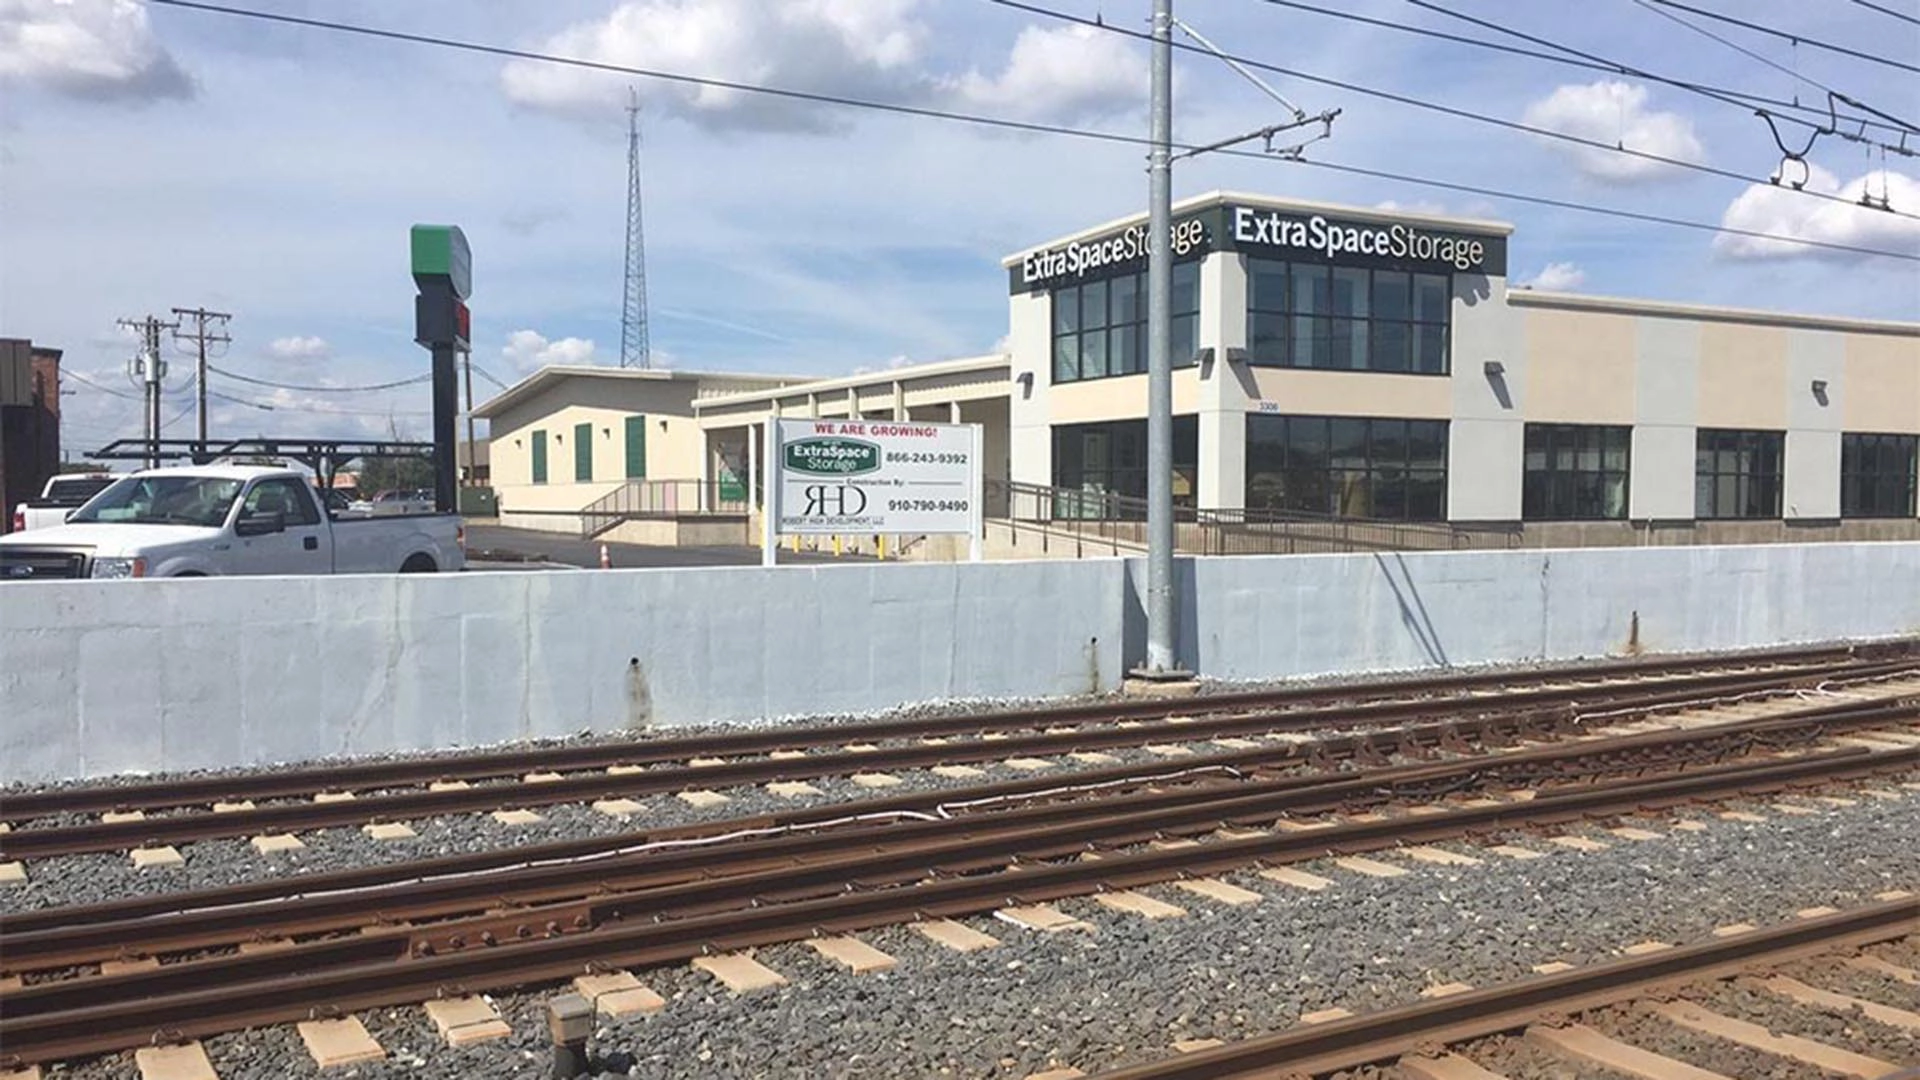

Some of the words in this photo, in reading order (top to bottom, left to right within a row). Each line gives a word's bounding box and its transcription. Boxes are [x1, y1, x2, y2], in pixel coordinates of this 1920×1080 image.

[815, 424, 835, 434] WE
[840, 425, 865, 435] ARE
[871, 426, 938, 437] GROWING!
[794, 445, 870, 460] ExtraSpace
[886, 452, 968, 464] 866-243-9392
[807, 458, 857, 472] Storage
[846, 477, 891, 486] Construction
[888, 500, 968, 512] 910-790-9490
